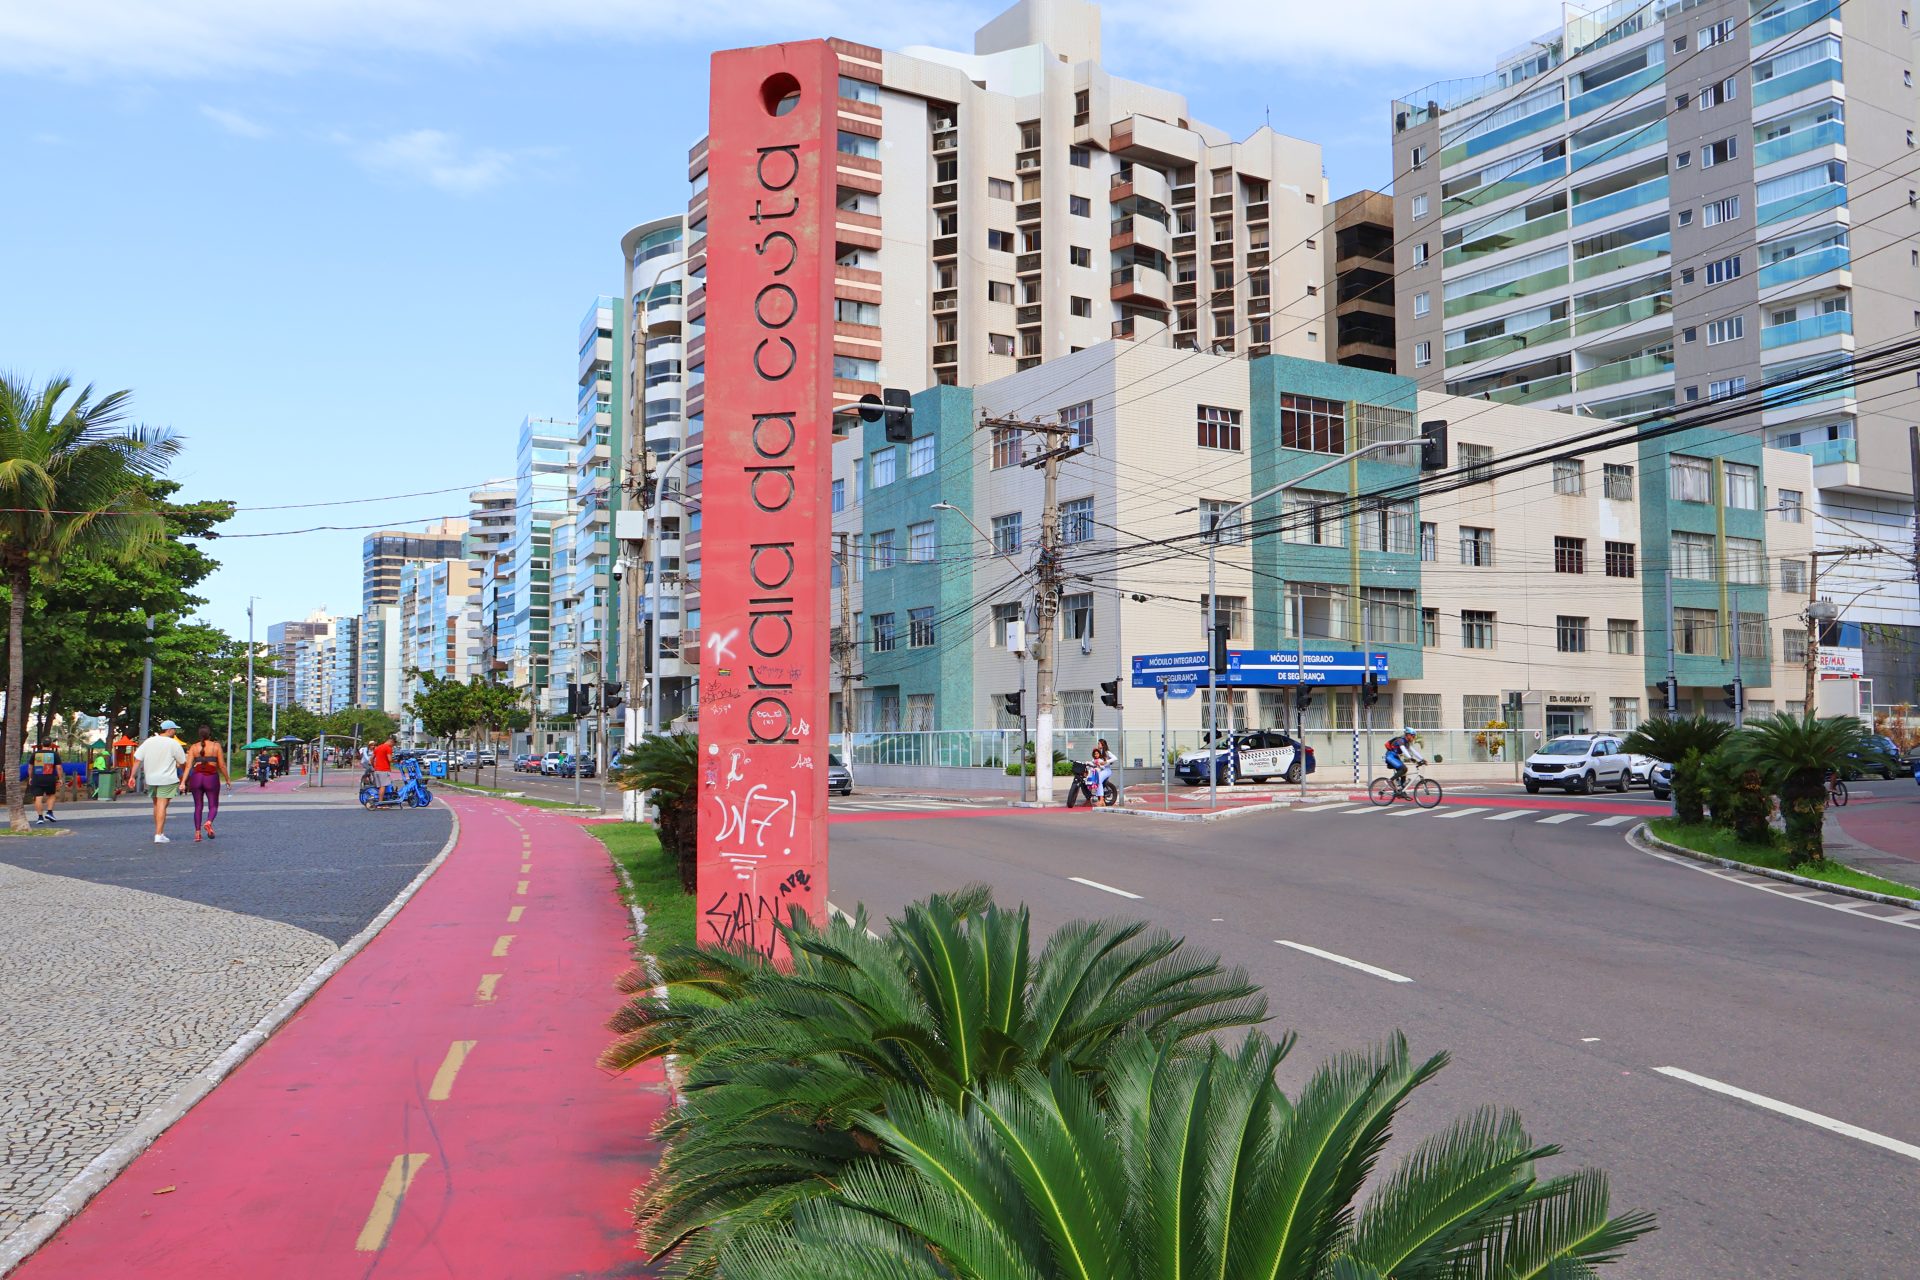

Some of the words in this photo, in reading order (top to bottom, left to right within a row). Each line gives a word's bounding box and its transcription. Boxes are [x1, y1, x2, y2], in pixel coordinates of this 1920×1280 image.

[749, 144, 800, 381] costa
[744, 412, 796, 513] da
[1149, 657, 1173, 666] MÓDULO
[1173, 655, 1206, 665] INTEGRADO
[1270, 653, 1298, 663] MÓDULO
[1303, 655, 1334, 663] TEGRADO
[1820, 656, 1845, 666] RE/MAX
[1278, 672, 1287, 680] DE
[1287, 672, 1325, 682] SEGRANÇA
